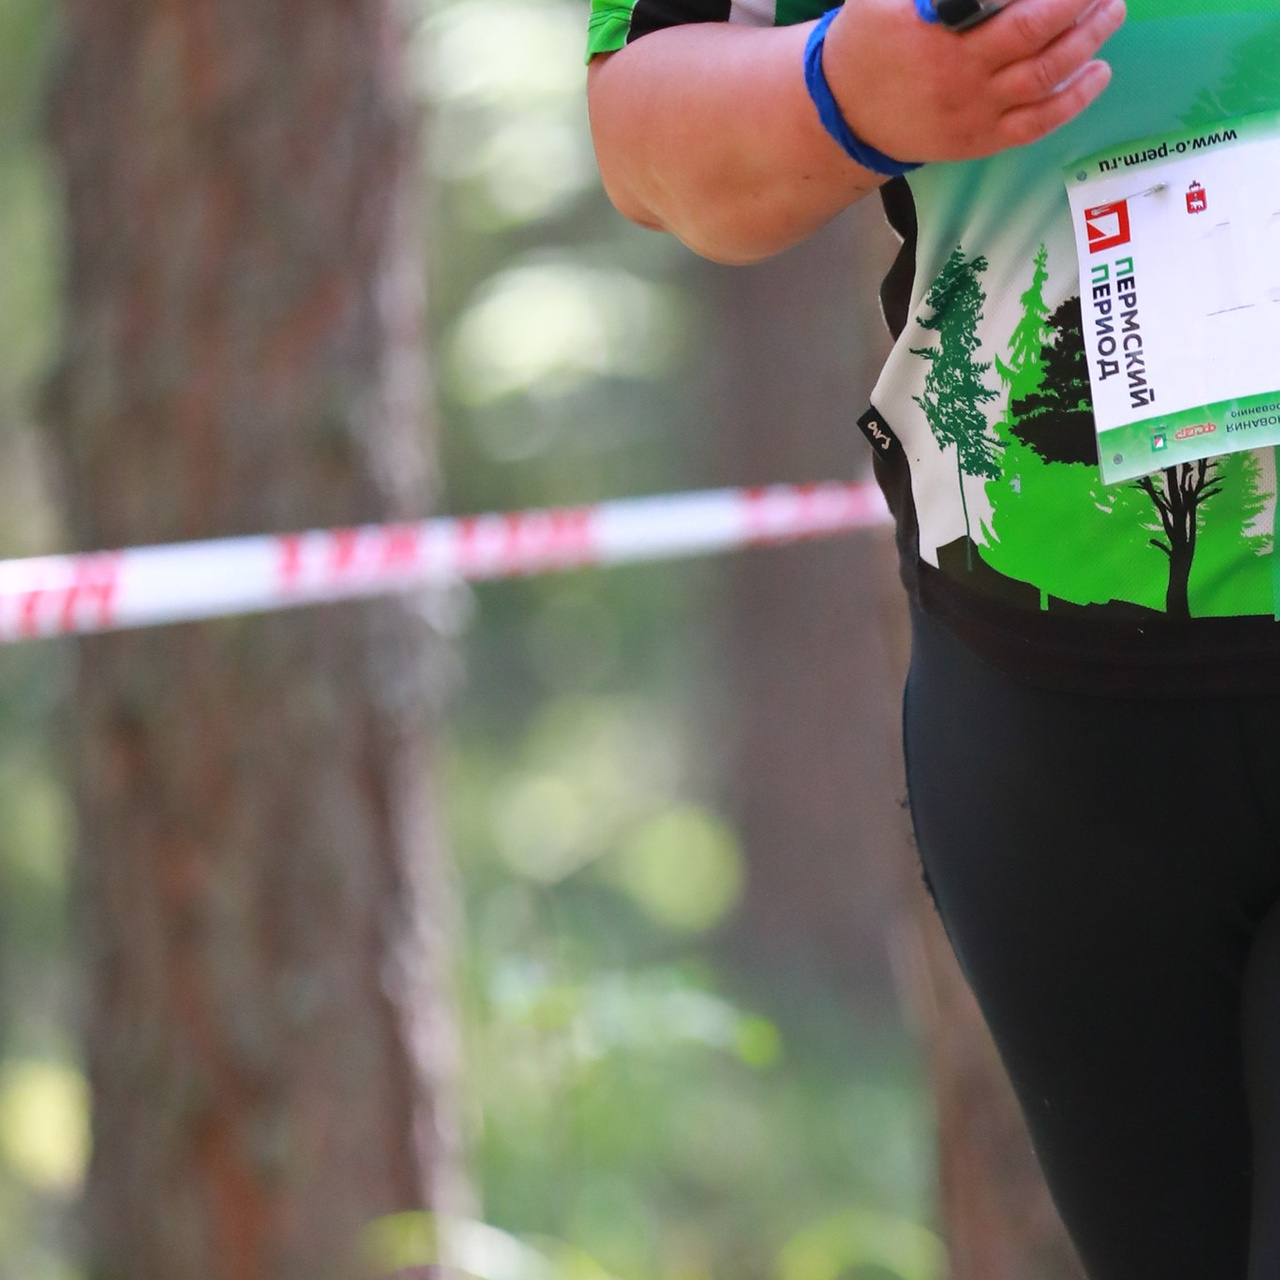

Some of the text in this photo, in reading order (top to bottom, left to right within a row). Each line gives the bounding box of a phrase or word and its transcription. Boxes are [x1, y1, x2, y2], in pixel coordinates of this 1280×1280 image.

[1098, 129, 1238, 172] www.o-perm.ru
[1091, 263, 1120, 381] ПЕРИОД
[1115, 256, 1155, 409] ПЕРМСКИЙ
